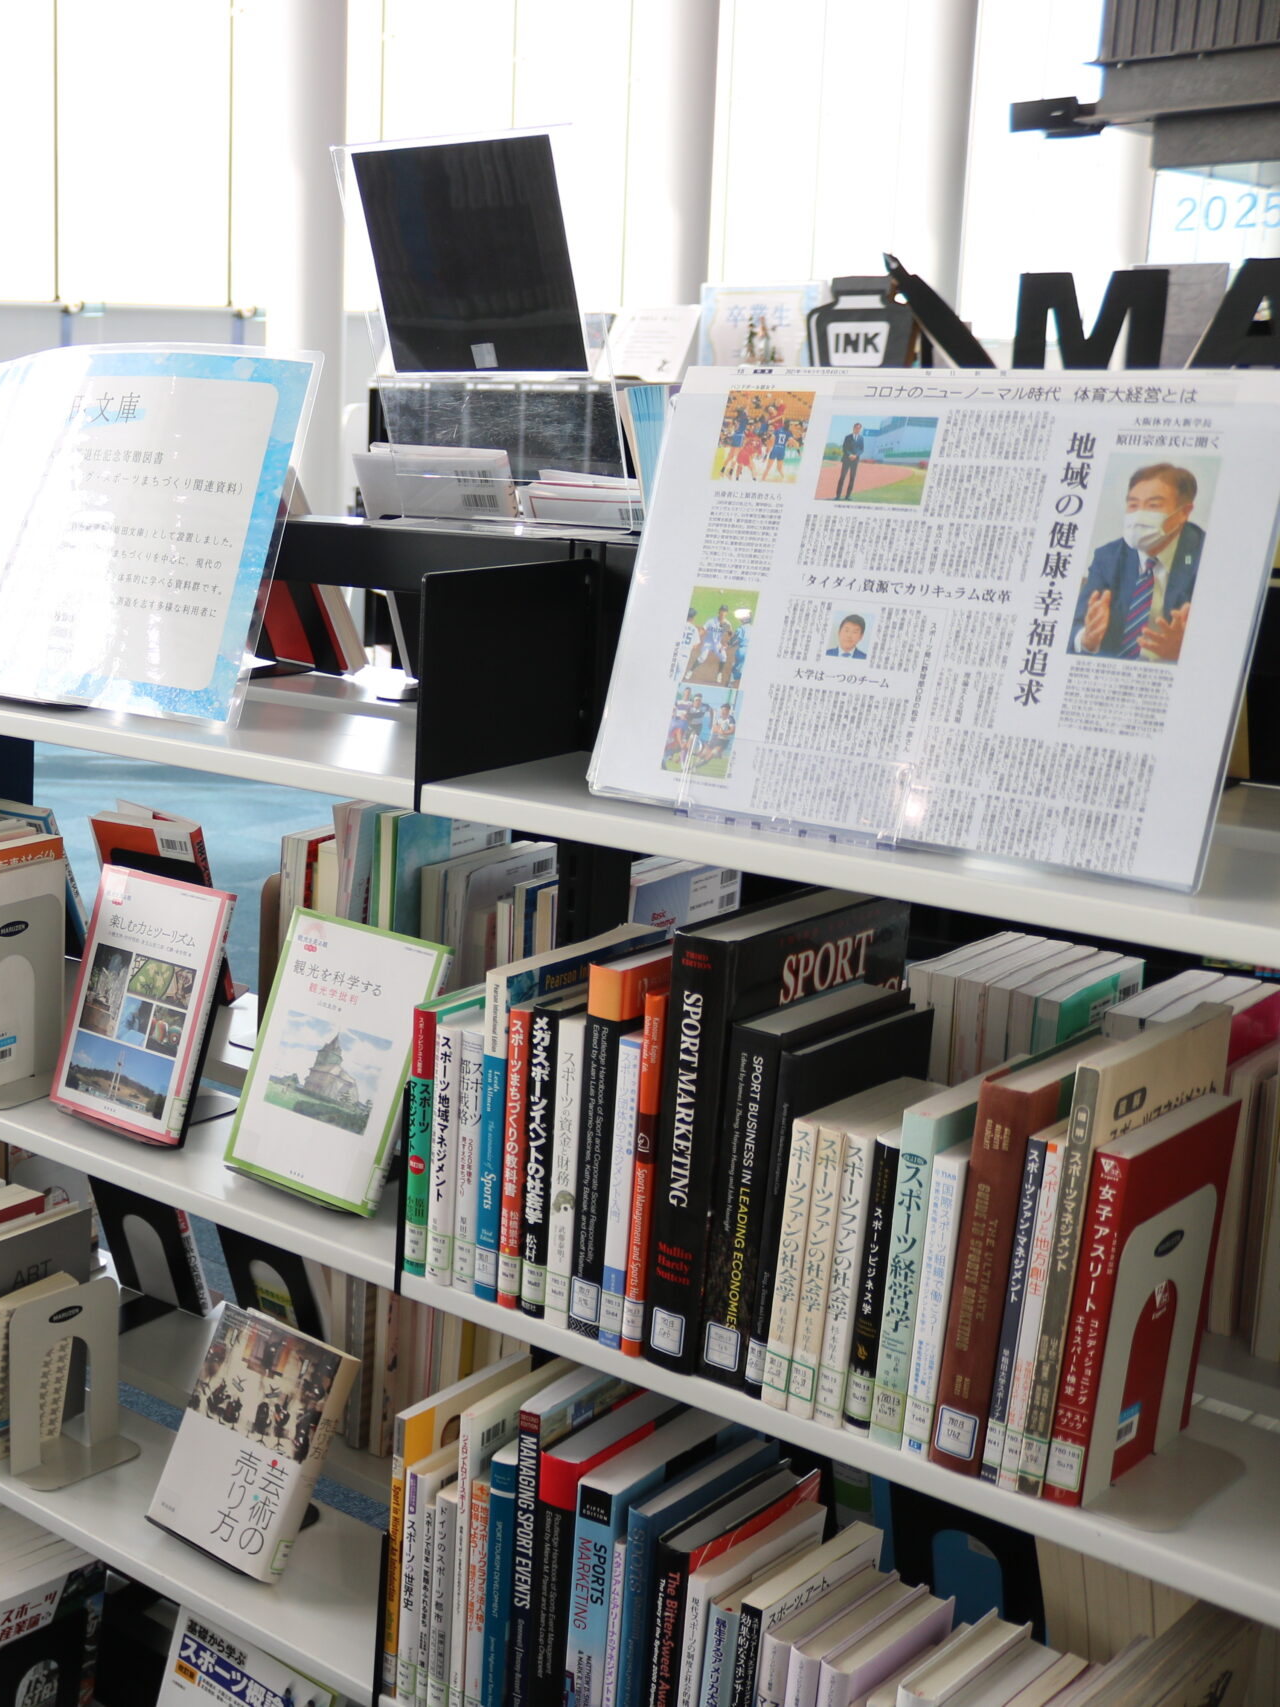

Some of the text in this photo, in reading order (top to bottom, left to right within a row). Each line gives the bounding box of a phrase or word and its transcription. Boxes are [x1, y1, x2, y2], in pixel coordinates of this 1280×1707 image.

[1174, 192, 1280, 232] 2025
[834, 331, 882, 354] INK
[864, 384, 1198, 405] コロナのニューノーマル時代 体育大経営とは
[1116, 433, 1220, 450] 原田宗彦氏に聞く
[1014, 431, 1096, 707] 地域の健康・幸福追求
[793, 668, 889, 689] 大学は一つのチーム
[109, 914, 197, 948] 楽しむ力とツーリズム
[685, 950, 709, 962] THIRD
[293, 959, 383, 998] 観光を科学する
[681, 958, 712, 970] EDITION
[780, 929, 874, 1006] SPORT
[308, 982, 359, 1006] 観光学批判
[591, 1024, 599, 1048] Edited
[597, 1026, 608, 1065] Routledge
[469, 1062, 484, 1129] スポーツ
[589, 1061, 597, 1081] Juan
[595, 1066, 606, 1104] Handbook
[407, 1080, 418, 1152] マネジメント
[418, 1082, 431, 1134] スポーツ
[435, 1035, 452, 1203] スポーツ地域マネジメント
[503, 1018, 525, 1198] スポーツまちづくりの教科書
[524, 1016, 550, 1225] メガ・スポーツイベントの社会学
[556, 1052, 575, 1188] スポーツの資金と財務
[667, 990, 702, 1208] SPORT MARKETING
[592, 1115, 603, 1136] Sport
[593, 1137, 601, 1152] and
[480, 1171, 496, 1210] Sports
[588, 1153, 600, 1190] Corporate
[635, 1169, 647, 1192] Sports
[726, 1056, 762, 1328] SPORT BUSINESS IN LEADING ECONOMIES
[588, 1191, 597, 1213] Social
[631, 1195, 644, 1243] Management
[775, 1127, 811, 1304] スポーツファンの社会学
[801, 1138, 837, 1313] スポーツファンの社会学
[1009, 1149, 1039, 1303] スポーツ・ファン・マネジメント
[1056, 1151, 1083, 1273] スポーツマネジメント
[631, 1246, 640, 1260] and
[659, 1241, 693, 1260] Mullin
[827, 1142, 864, 1322] スポーツファンの社会学
[885, 1164, 923, 1334] スポーツ経営学
[1027, 1163, 1060, 1298] スポーツと地方創生
[1086, 1183, 1116, 1313] 女子アスリート
[628, 1261, 639, 1285] Sports
[656, 1266, 690, 1286] Sutton
[658, 1253, 690, 1273] Hardy
[861, 1207, 883, 1317] スポーツビジネス学
[925, 1182, 956, 1337] 国際スポーツ組織で働こう!
[964, 1238, 982, 1283] SPORTS
[974, 1218, 998, 1321] THE ULTIMATE
[954, 1285, 976, 1351] MARKETING
[1065, 1314, 1084, 1397] エキスパート検定
[1078, 1318, 1099, 1406] コンディショニング
[209, 1449, 262, 1543] 売り方
[238, 1462, 290, 1556] 芸術の
[582, 1509, 608, 1521] EDITION
[512, 1435, 537, 1608] MANAGING SPORT EVENTS
[402, 1520, 417, 1611] スポーツの世界史
[572, 1537, 591, 1629] MARKETING
[586, 1541, 609, 1604] SPORTS
[666, 1571, 680, 1596] The
[1, 1590, 58, 1627] スポーツ
[655, 1592, 664, 1616] Legacy
[186, 1618, 247, 1667] 基礎から学ぶ
[659, 1598, 677, 1677] Bitter-Sweet
